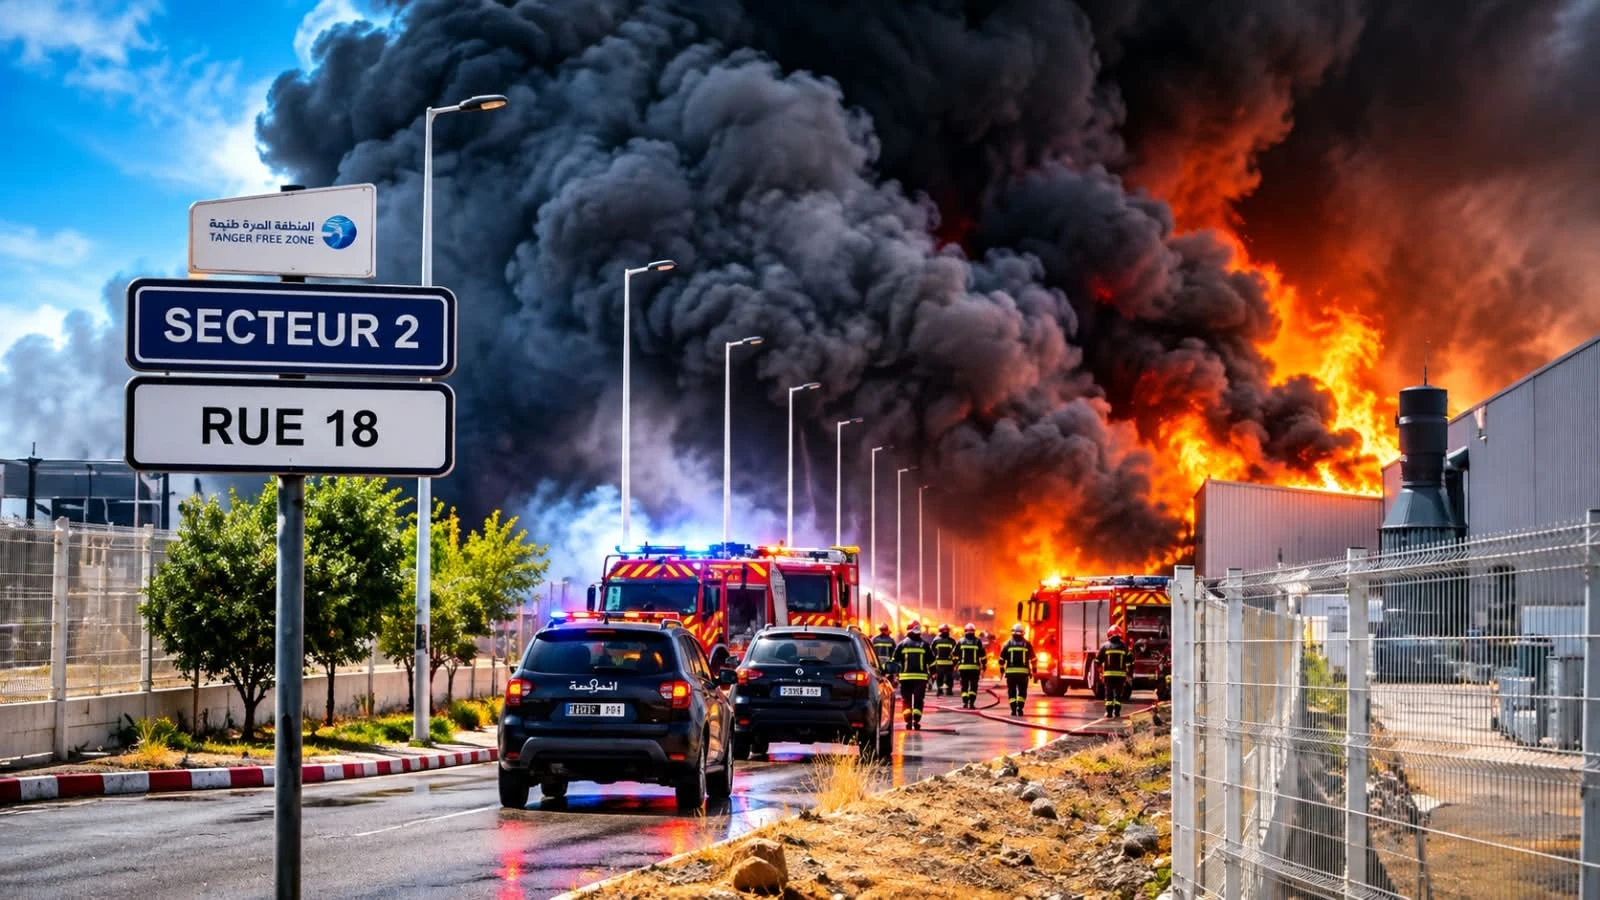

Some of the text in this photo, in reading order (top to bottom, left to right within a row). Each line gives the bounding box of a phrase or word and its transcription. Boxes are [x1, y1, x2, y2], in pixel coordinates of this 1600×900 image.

[209, 232, 315, 245] TANGER FREE ZONE
[164, 307, 419, 349] SECTEUR 2
[201, 406, 379, 448] RUE 18
